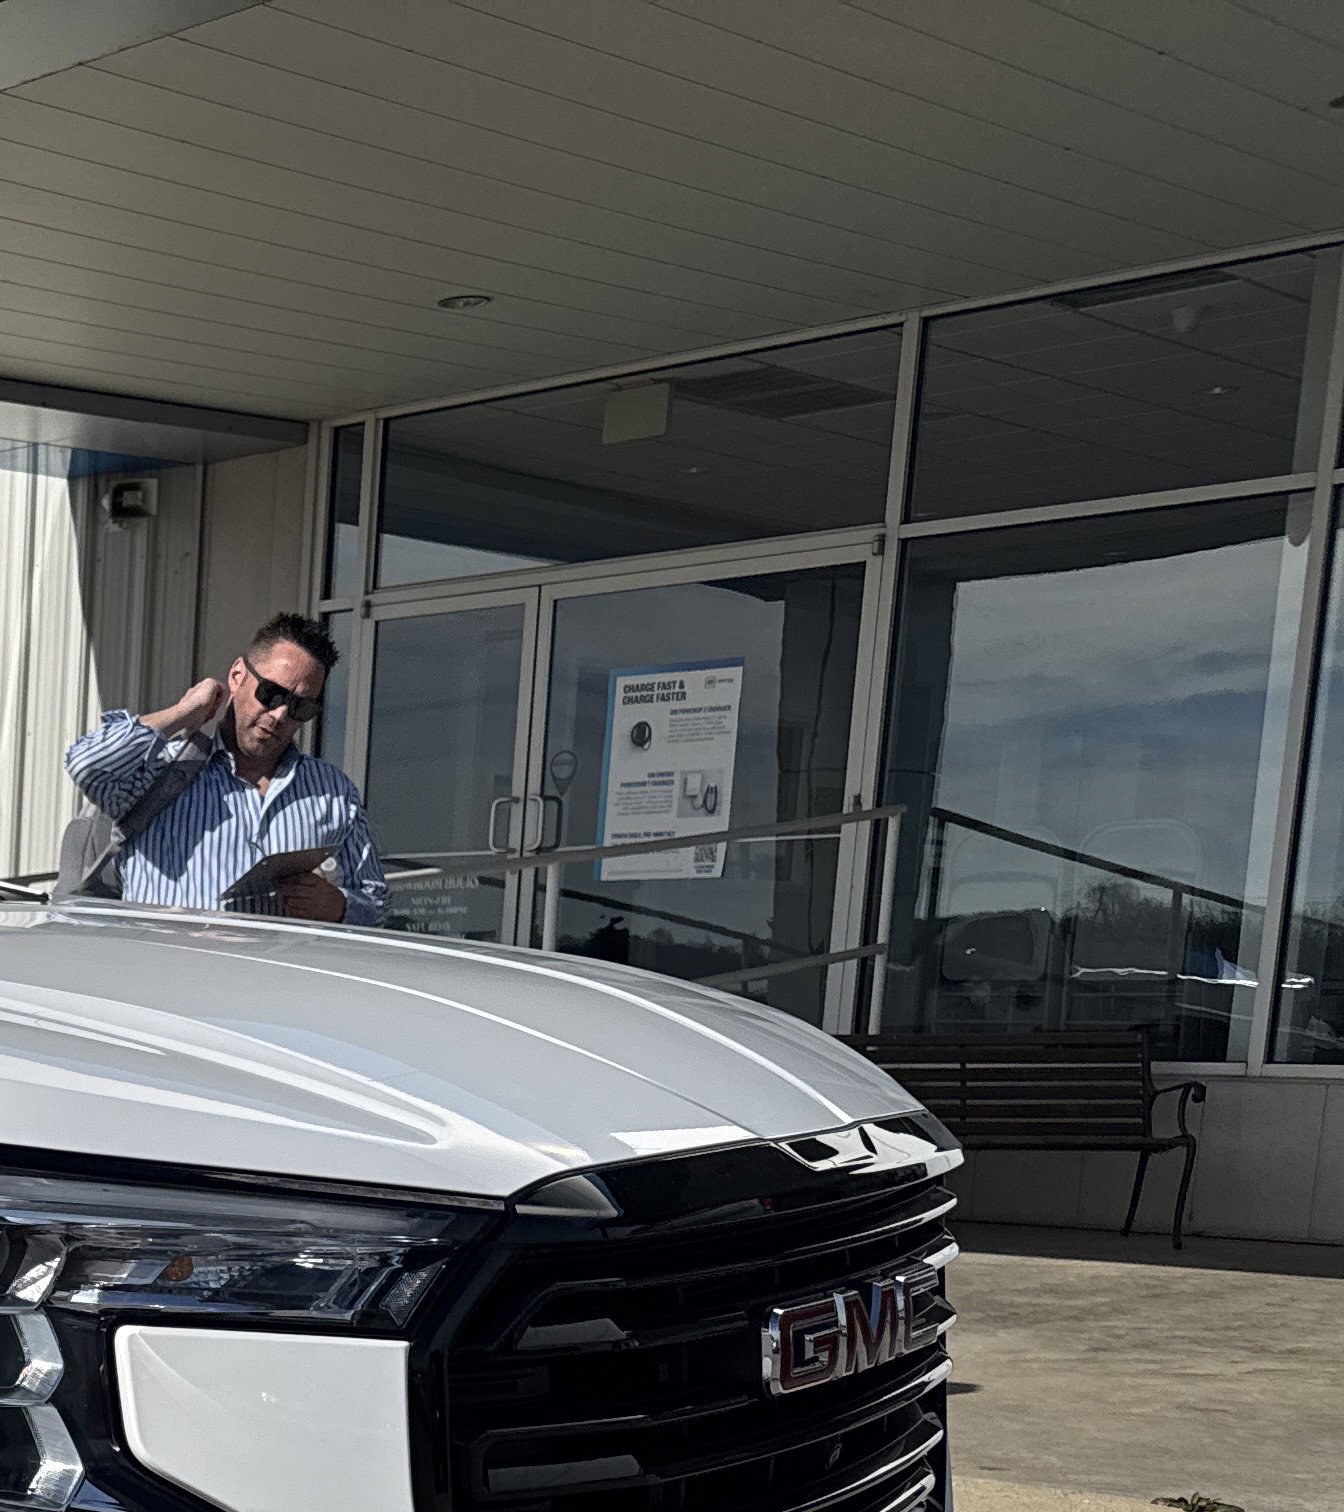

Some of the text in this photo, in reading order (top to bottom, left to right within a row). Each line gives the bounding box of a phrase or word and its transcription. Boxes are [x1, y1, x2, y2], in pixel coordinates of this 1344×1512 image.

[623, 680, 685, 694] CHARGE FAST &
[622, 691, 687, 705] CHARGE FASTER
[762, 1268, 939, 1394] GMC
